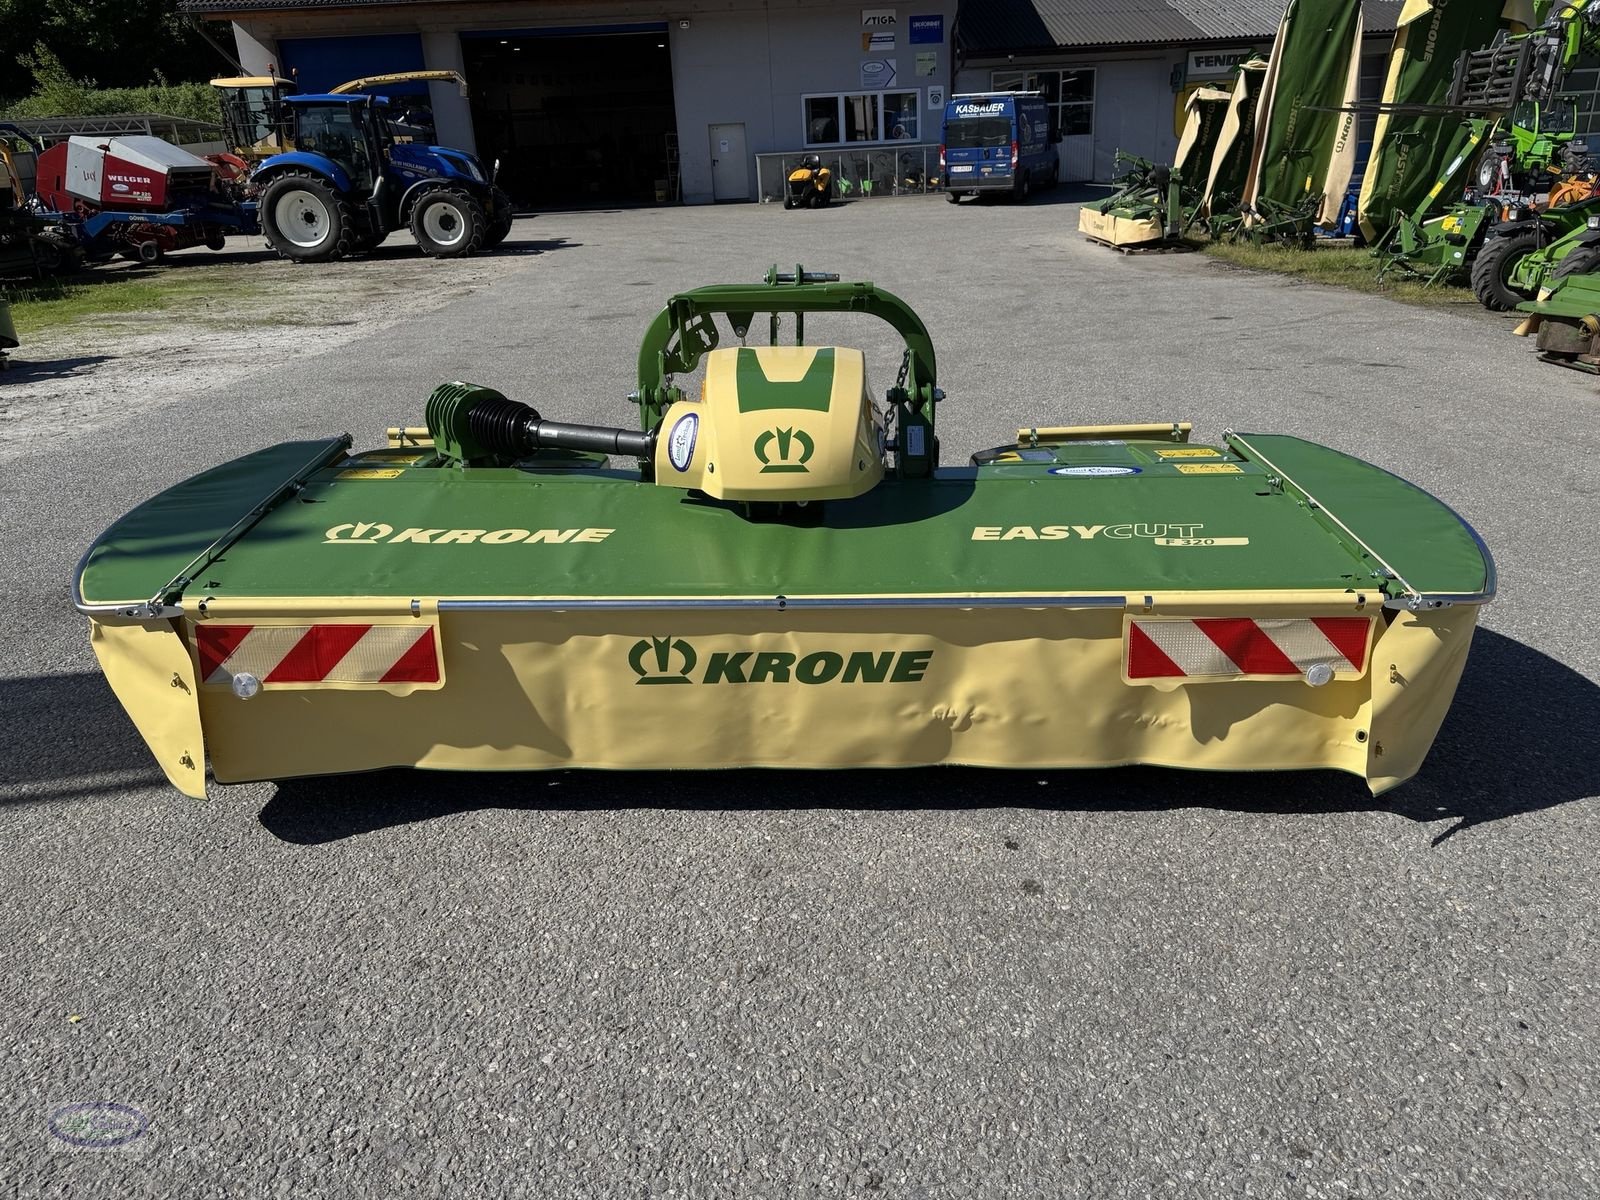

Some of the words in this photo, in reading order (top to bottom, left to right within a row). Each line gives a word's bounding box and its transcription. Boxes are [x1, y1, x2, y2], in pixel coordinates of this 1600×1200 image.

[864, 16, 896, 25] STIGA
[1424, 8, 1443, 62] KRONE
[1194, 55, 1241, 67] FEND
[955, 103, 1004, 113] KASBAUER
[108, 175, 151, 184] WELGER
[389, 528, 616, 544] KRONE
[971, 523, 1204, 541] EASYCUT
[702, 650, 934, 685] KRONE
